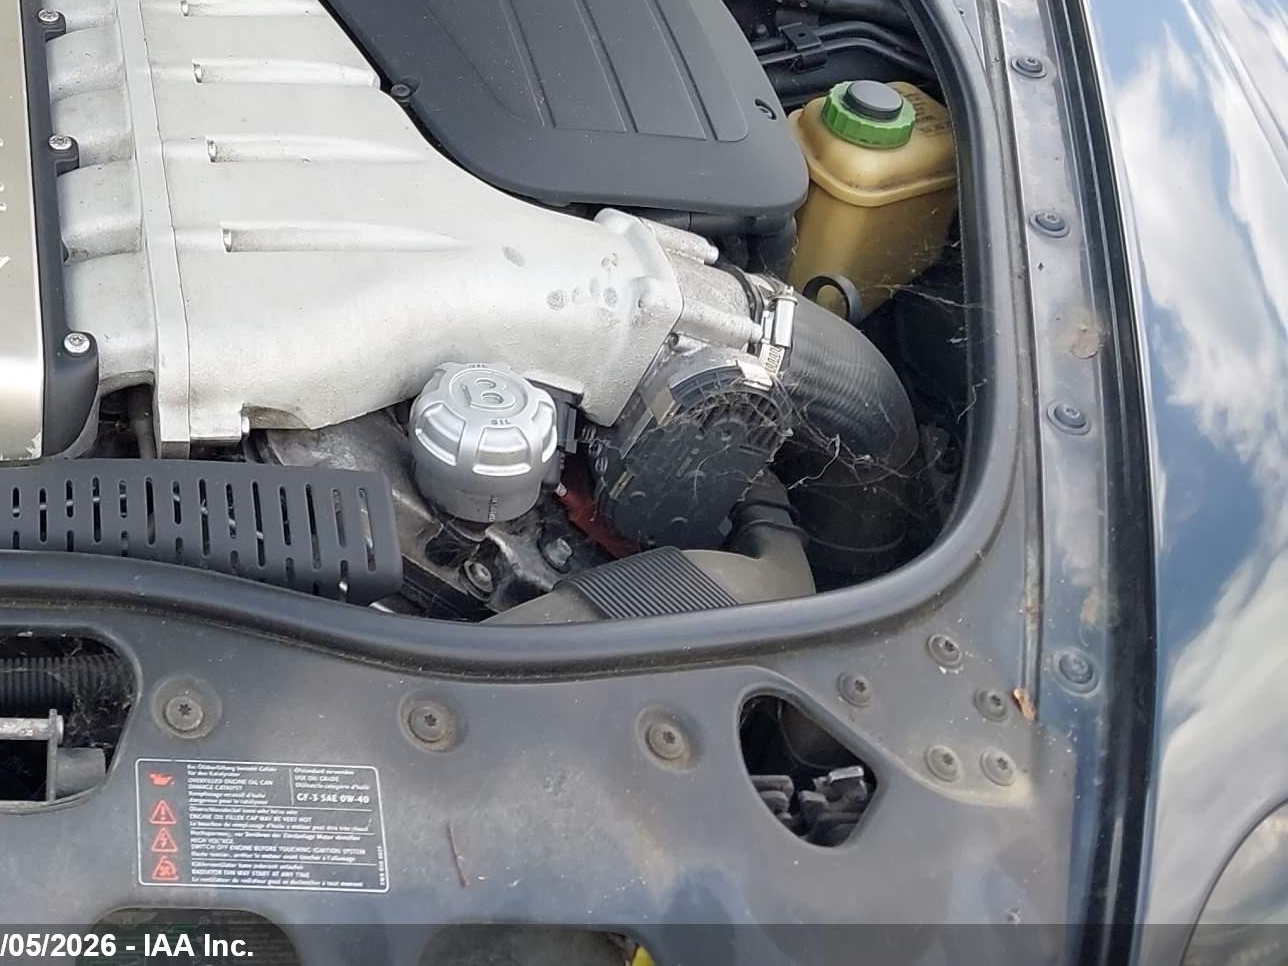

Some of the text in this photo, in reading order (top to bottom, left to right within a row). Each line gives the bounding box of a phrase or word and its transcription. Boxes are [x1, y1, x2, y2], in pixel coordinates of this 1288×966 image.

[460, 378, 518, 411] B
[490, 418, 513, 426] OIL
[320, 794, 337, 802] SAE
[340, 795, 370, 803] 0W-40
